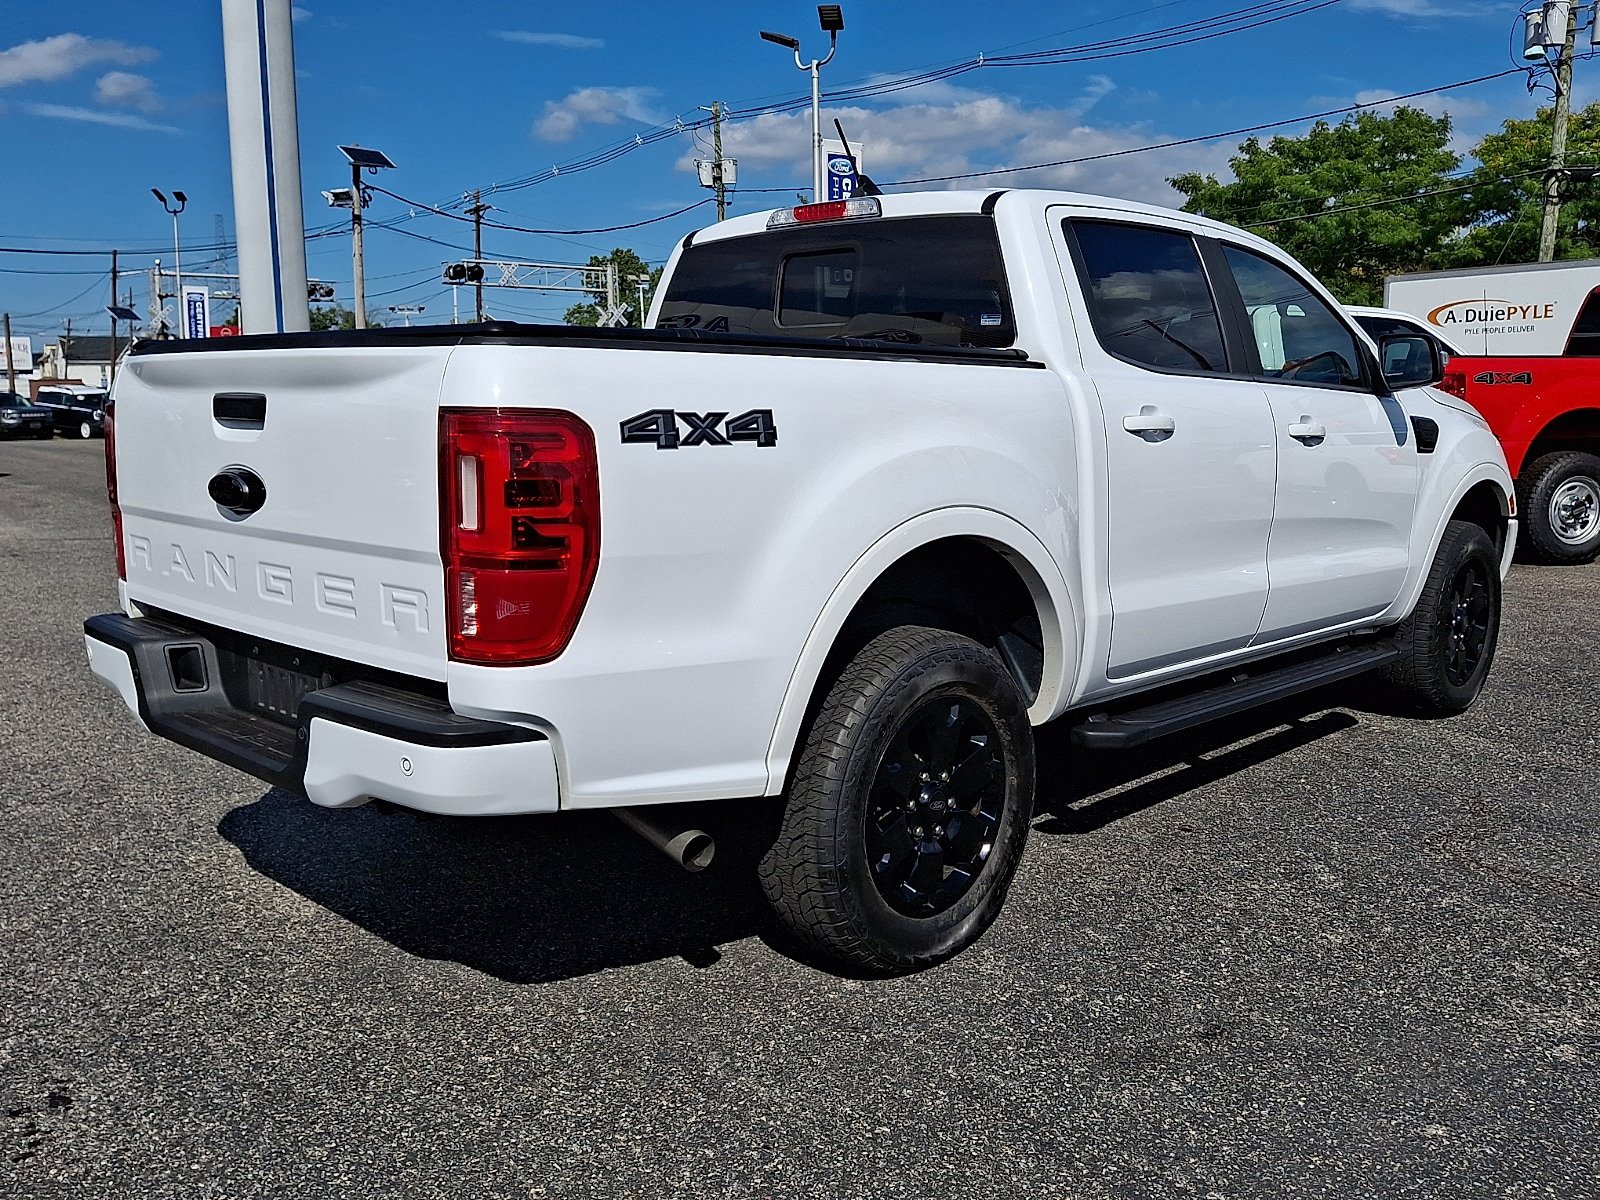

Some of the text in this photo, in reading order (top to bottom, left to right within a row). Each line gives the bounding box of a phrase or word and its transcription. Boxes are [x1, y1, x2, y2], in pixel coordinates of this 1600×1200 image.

[1464, 325, 1535, 335] PYLE PEOPLE DELIVER
[129, 533, 430, 634] RANGER
